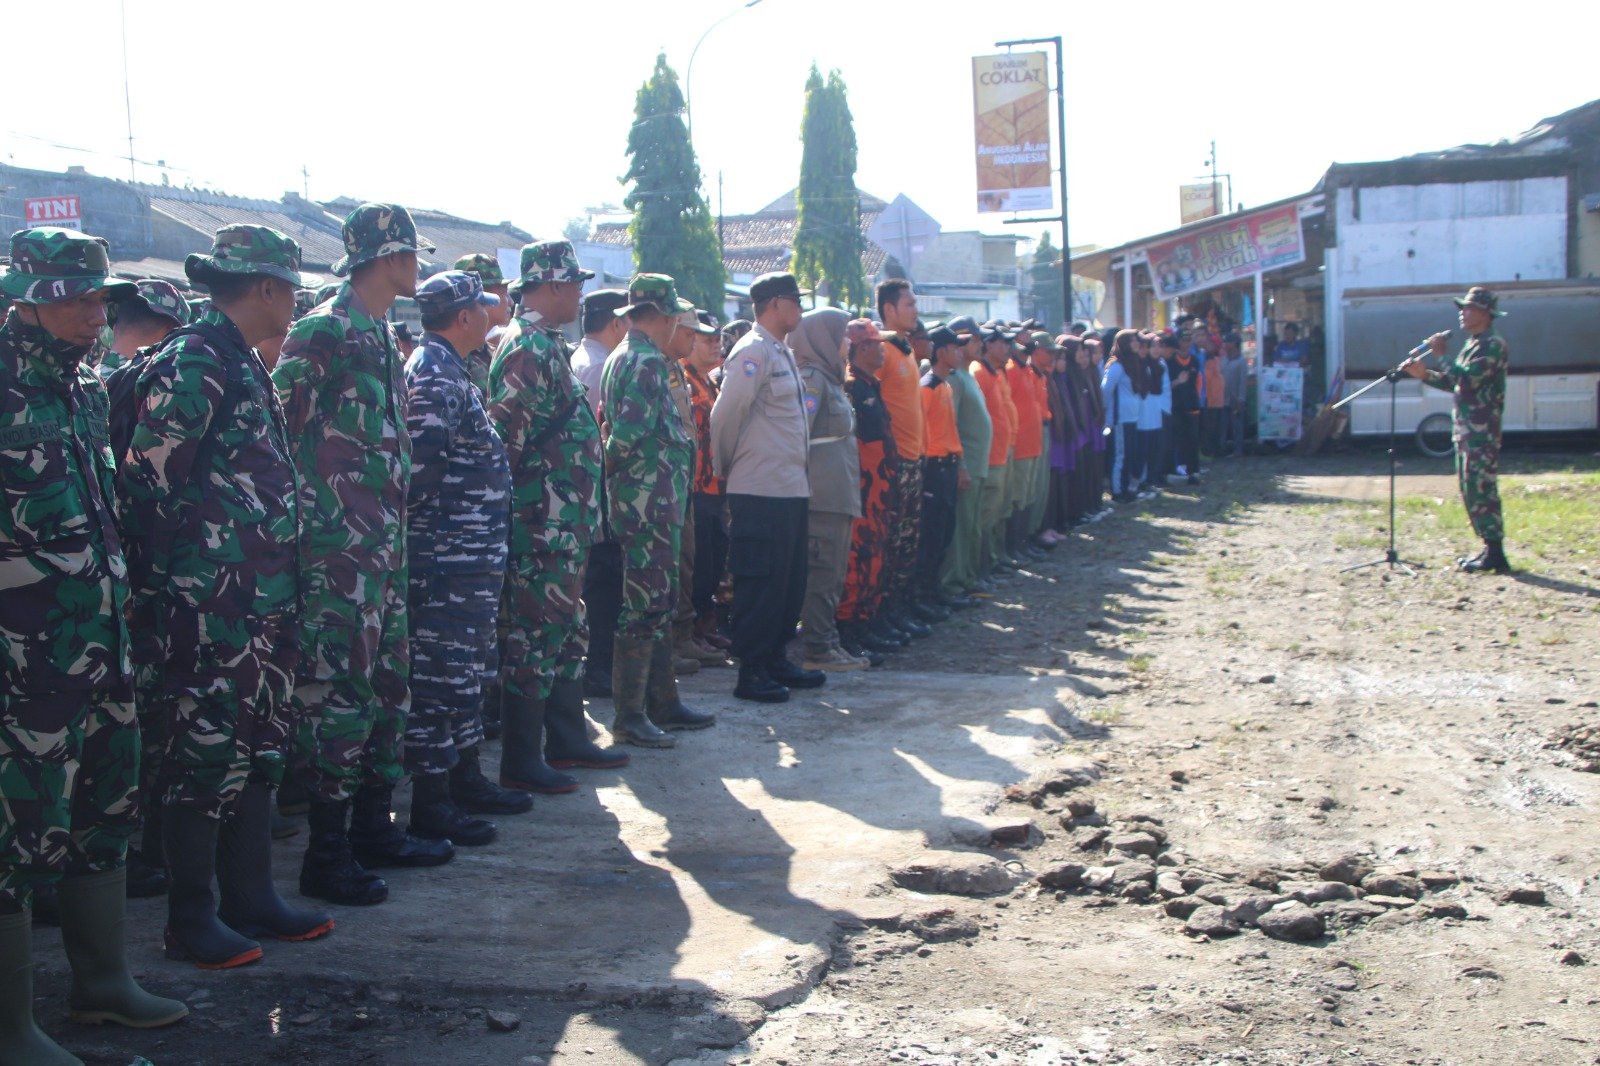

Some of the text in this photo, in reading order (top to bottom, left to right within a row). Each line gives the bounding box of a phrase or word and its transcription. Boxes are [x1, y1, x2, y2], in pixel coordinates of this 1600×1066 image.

[980, 69, 1042, 85] COKLAT
[993, 152, 1048, 165] INDONESIA
[29, 199, 77, 219] TINI
